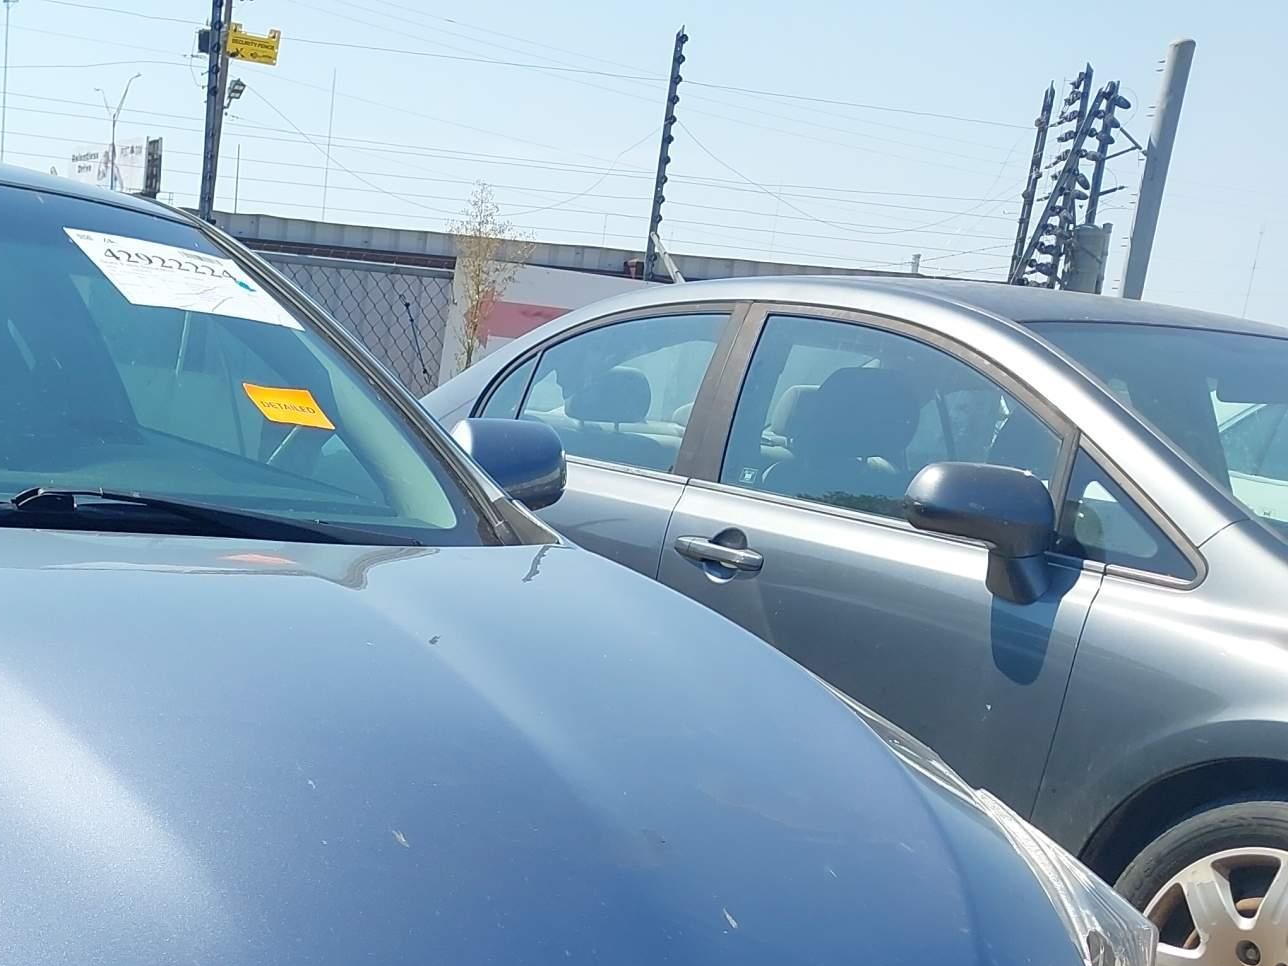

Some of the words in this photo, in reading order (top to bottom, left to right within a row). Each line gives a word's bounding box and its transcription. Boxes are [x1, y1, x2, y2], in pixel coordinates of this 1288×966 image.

[232, 38, 257, 48] SECURITY
[104, 248, 237, 282] 42922224
[260, 400, 316, 415] DETAILED
